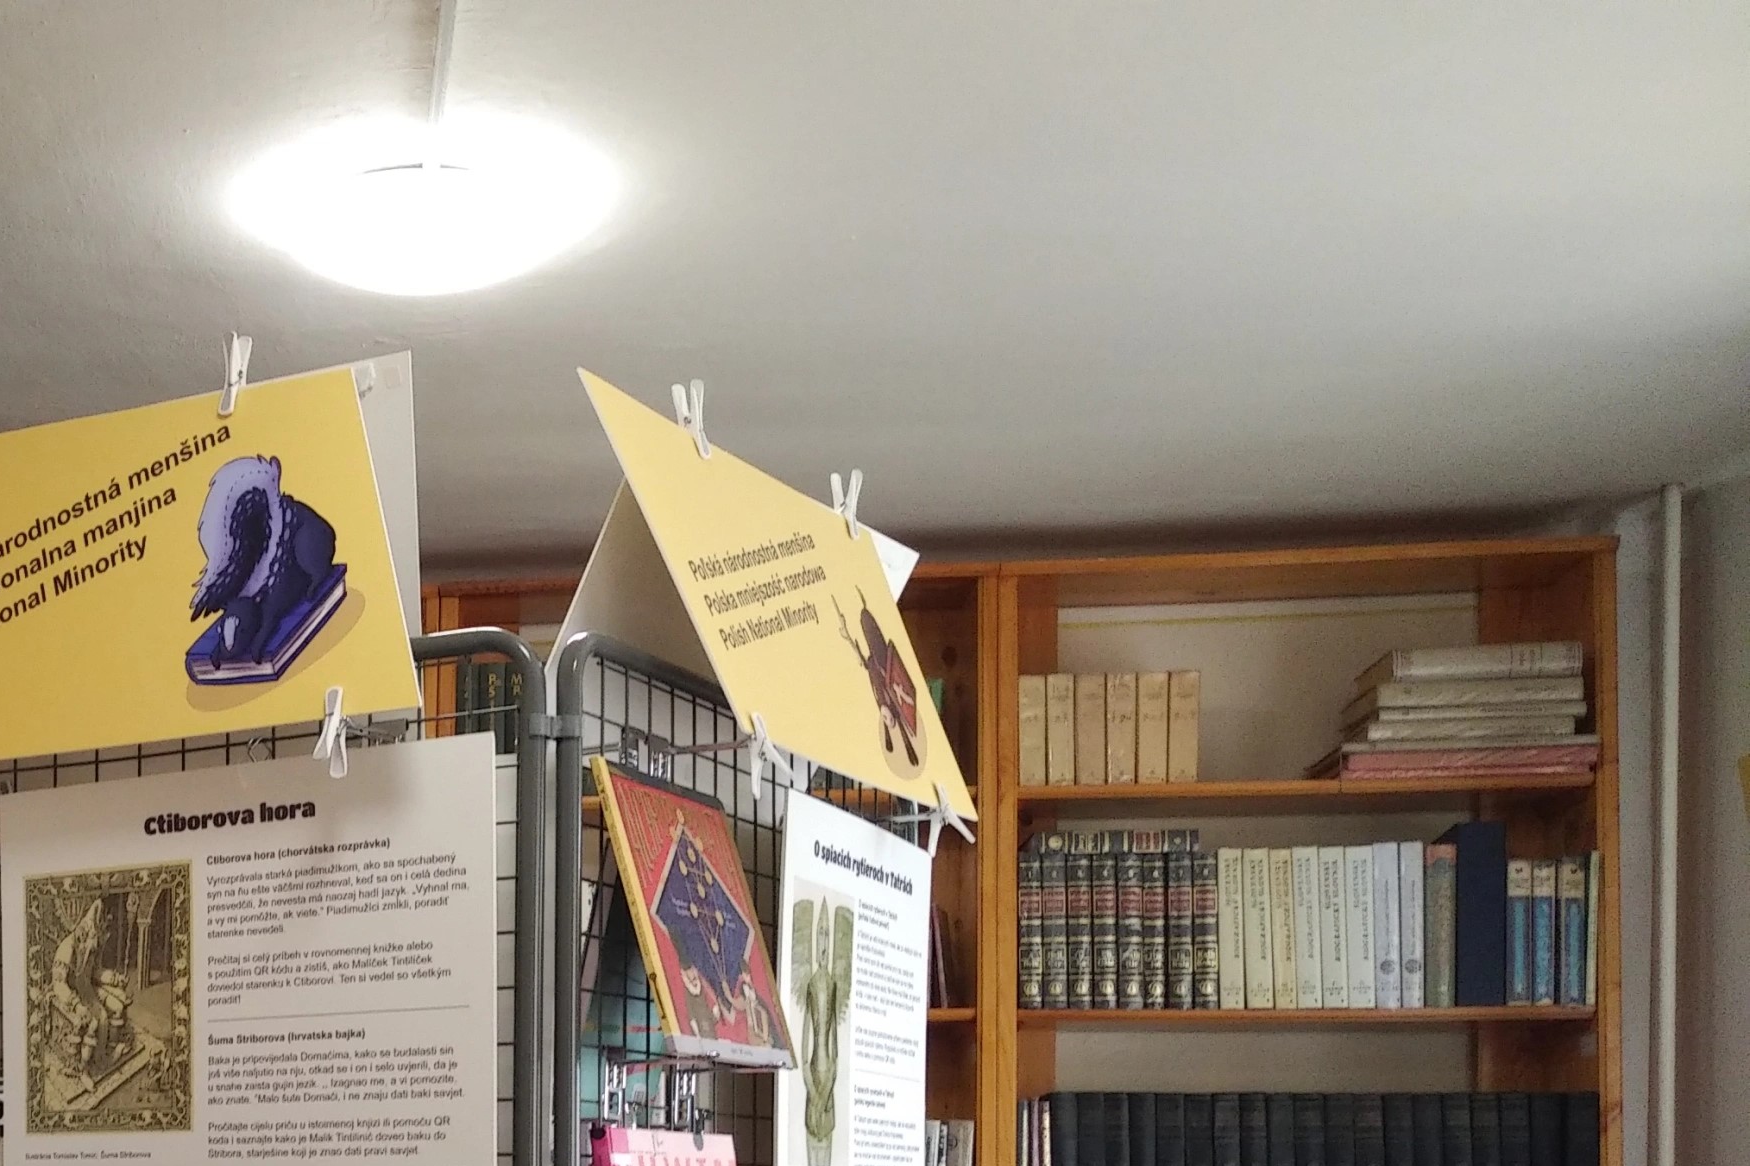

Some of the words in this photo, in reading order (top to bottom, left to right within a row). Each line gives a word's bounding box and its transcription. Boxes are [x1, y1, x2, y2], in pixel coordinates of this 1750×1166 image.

[128, 424, 232, 490] menšina
[82, 486, 177, 547] manjina
[53, 535, 147, 597] Minority
[722, 539, 779, 572] národnostná
[778, 531, 816, 558] menšina
[704, 589, 738, 616] Polska
[737, 572, 786, 606] mniejszość
[784, 564, 826, 590] narodowa
[719, 623, 751, 650] Polish
[745, 607, 785, 641] National
[781, 600, 819, 631] Minority
[144, 808, 255, 836] Ctiborova
[260, 801, 316, 822] hora
[206, 850, 251, 866] Ctiborova
[253, 848, 275, 861] hora
[277, 842, 334, 861] (chorvátska
[337, 837, 390, 855] rozprávka)
[814, 839, 820, 858] O
[821, 844, 852, 871] spiacich
[852, 858, 884, 885] rytieroch
[884, 874, 889, 886] v
[890, 873, 913, 896] Tatrách
[207, 1032, 233, 1046] Šuma
[287, 1028, 332, 1044] (hrvatska
[334, 1027, 365, 1042] bajka)
